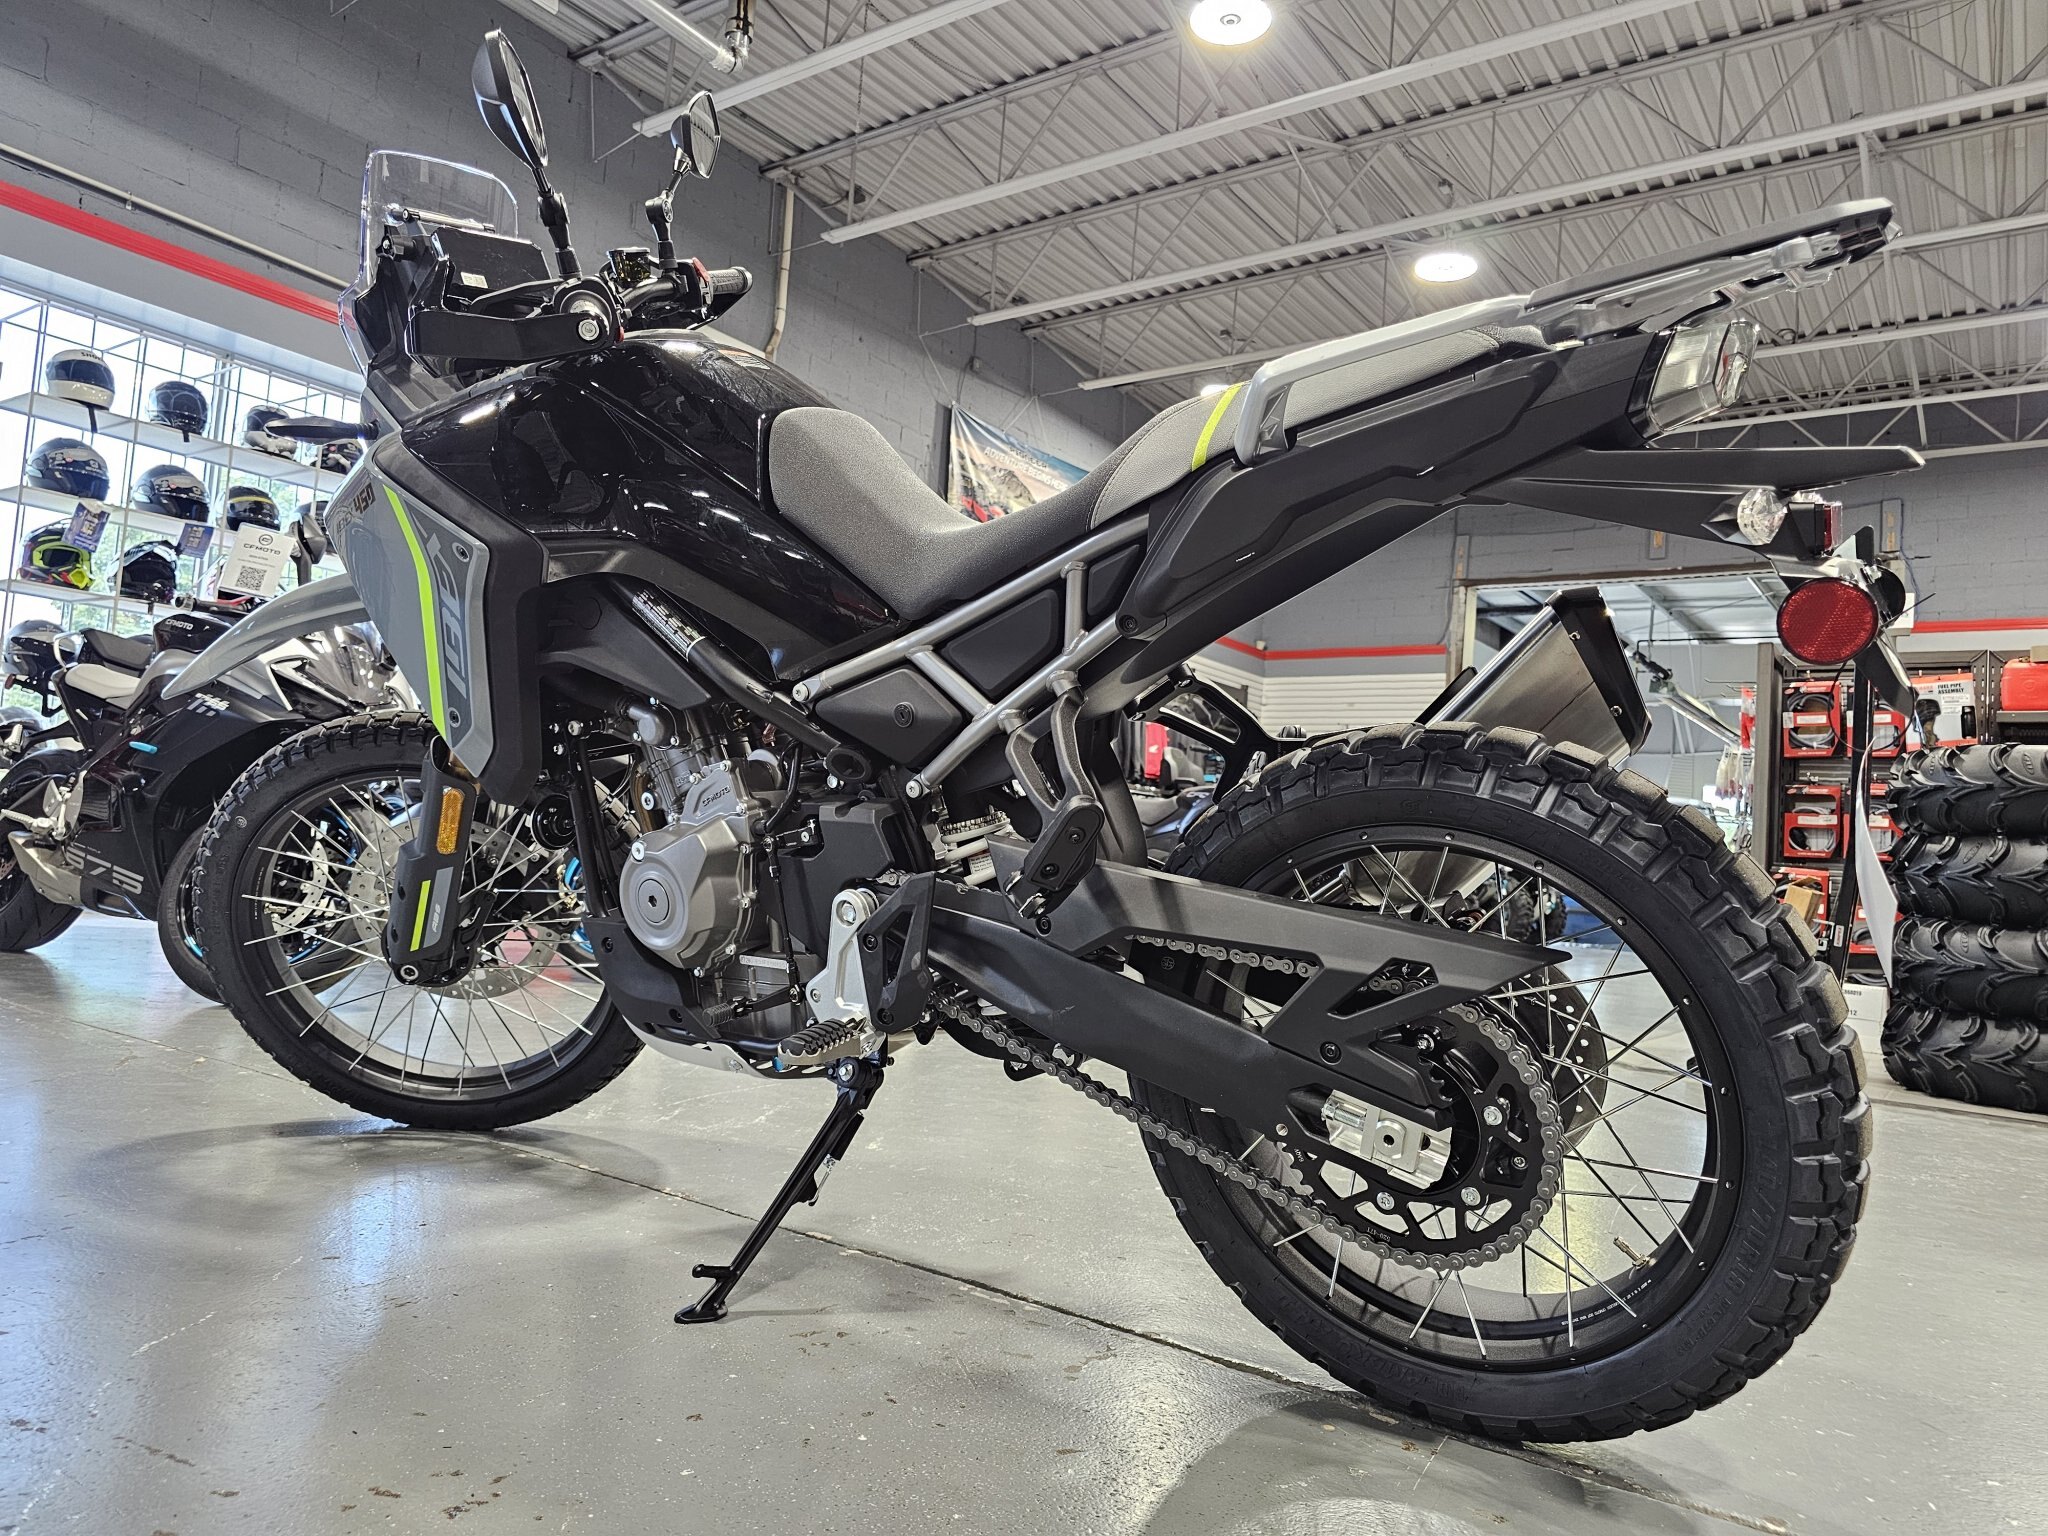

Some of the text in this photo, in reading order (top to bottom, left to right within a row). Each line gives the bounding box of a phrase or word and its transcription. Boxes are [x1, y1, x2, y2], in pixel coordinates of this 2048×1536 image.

[984, 446, 1028, 474] ADVENTURE
[353, 482, 376, 513] 450
[243, 543, 281, 555] CFMOTO
[165, 618, 194, 630] CFMOTO
[702, 785, 731, 807] CFMOTO
[66, 845, 144, 895] 675
[1366, 1226, 1391, 1243] 520-47T
